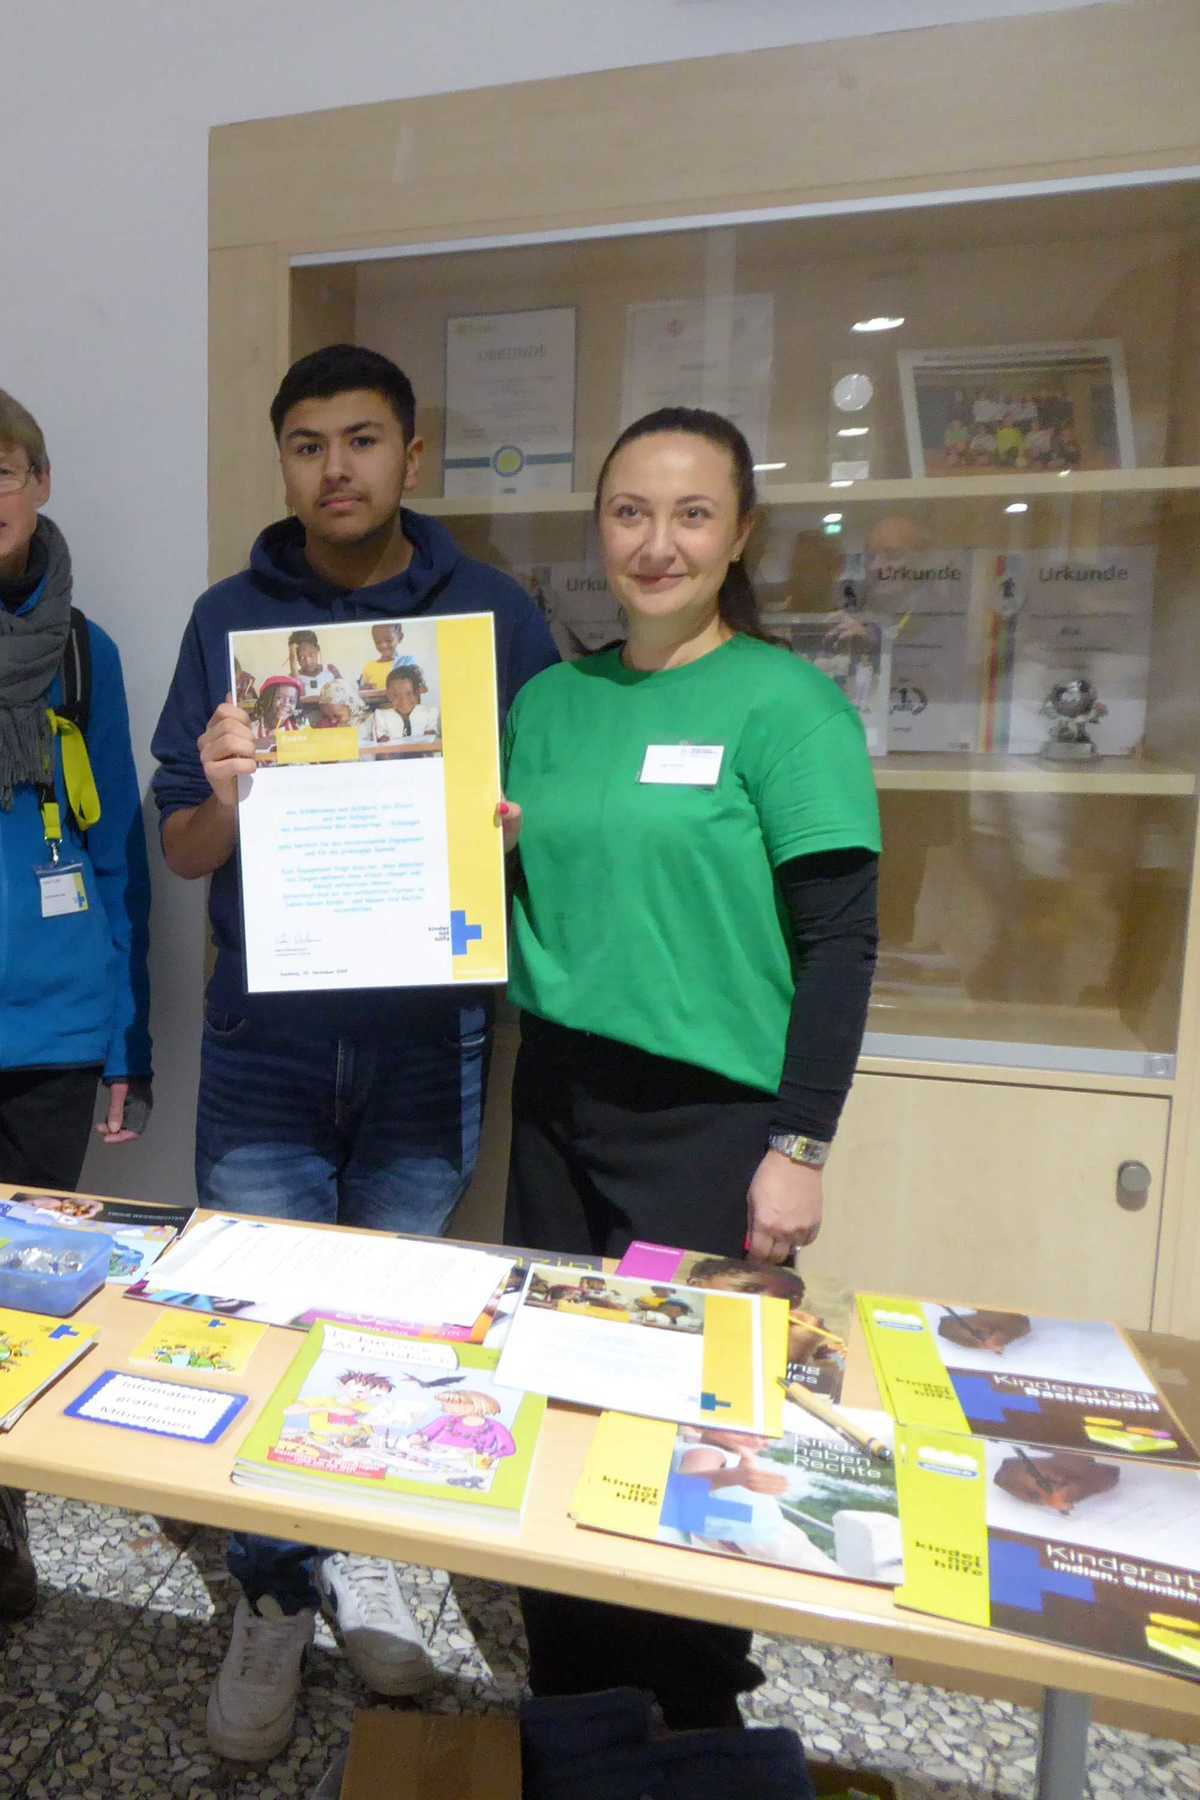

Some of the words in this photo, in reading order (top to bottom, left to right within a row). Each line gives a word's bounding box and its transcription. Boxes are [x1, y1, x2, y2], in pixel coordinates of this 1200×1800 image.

[877, 563, 963, 583] Urkunde
[1038, 564, 1129, 584] Urkunde
[992, 1374, 1159, 1401] Kinderarbeit
[794, 1443, 871, 1468] haben
[794, 1454, 882, 1479] Rechte
[601, 1474, 659, 1494] kinder
[615, 1491, 658, 1506] hilfe
[915, 1540, 982, 1562] kinder
[933, 1559, 983, 1576] hilfe
